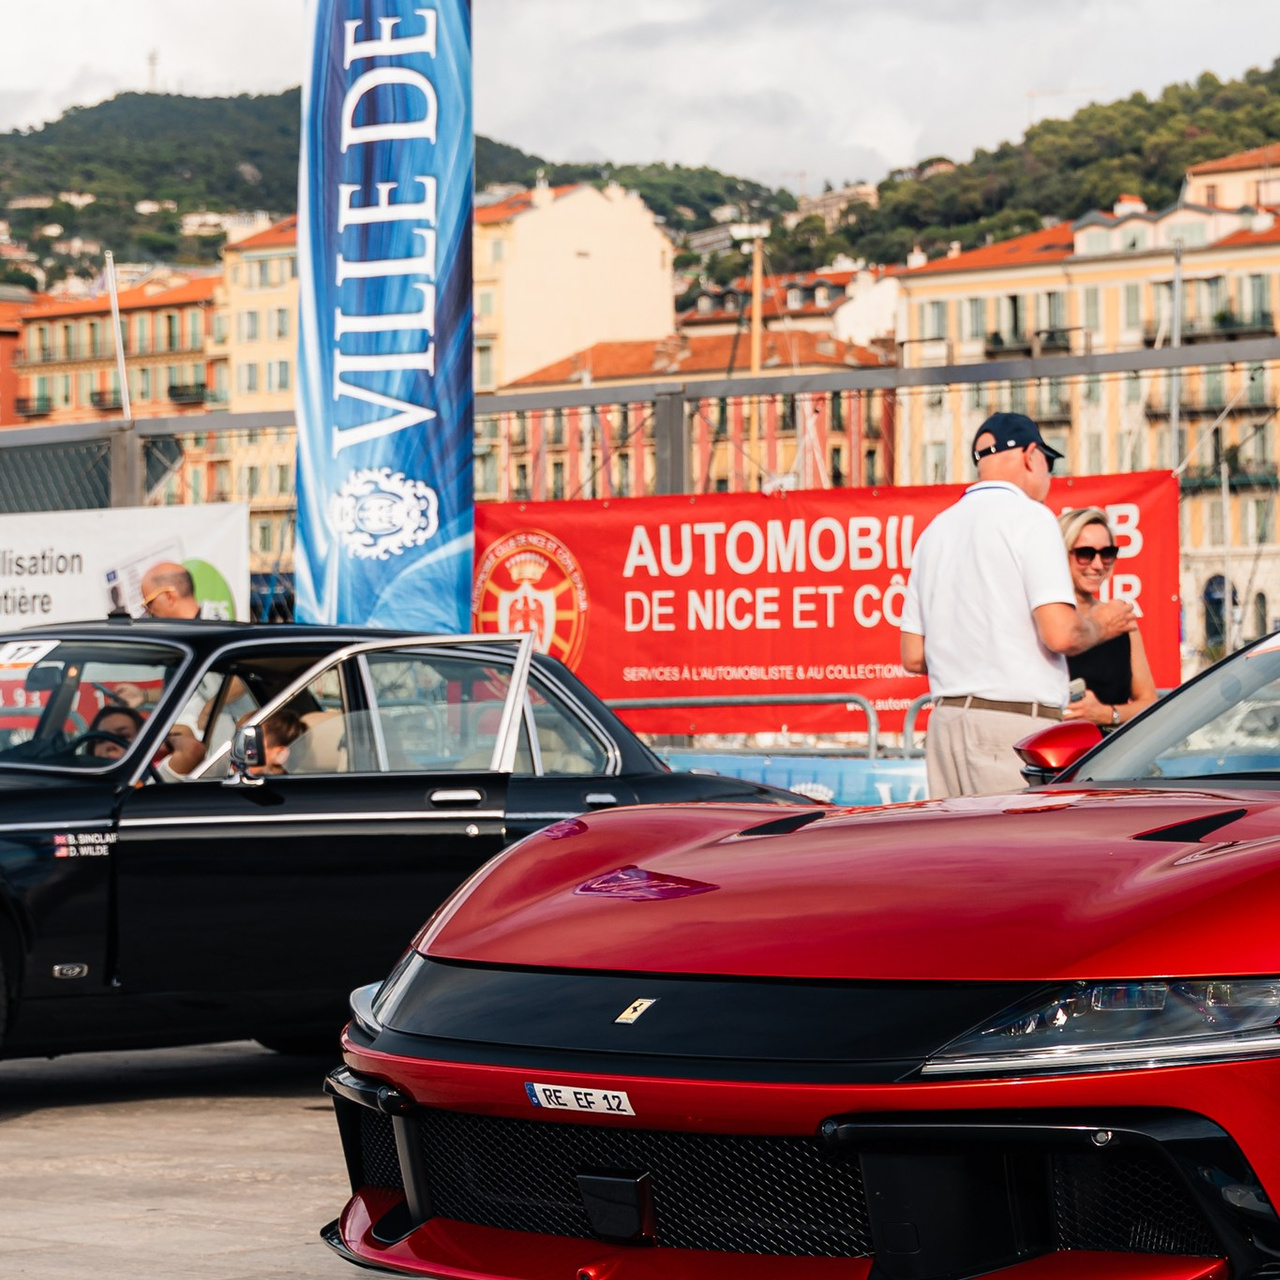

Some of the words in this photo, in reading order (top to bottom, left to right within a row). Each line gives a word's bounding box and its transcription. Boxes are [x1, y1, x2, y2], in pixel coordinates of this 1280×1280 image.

[340, 8, 438, 154] DE
[331, 175, 438, 460] VILLE
[0, 586, 52, 614] tière
[624, 590, 676, 632] DE
[687, 587, 780, 631] NICE
[793, 585, 843, 629] ET
[622, 666, 680, 681] SERVICES
[692, 665, 794, 681] L'AUTOMOBILISTE
[796, 665, 805, 680] &
[806, 665, 824, 680] AU
[826, 663, 922, 679] COLLECTION
[79, 845, 109, 856] WILDE
[542, 1088, 567, 1106] RE
[573, 1091, 595, 1109] EF
[602, 1093, 627, 1112] 12
